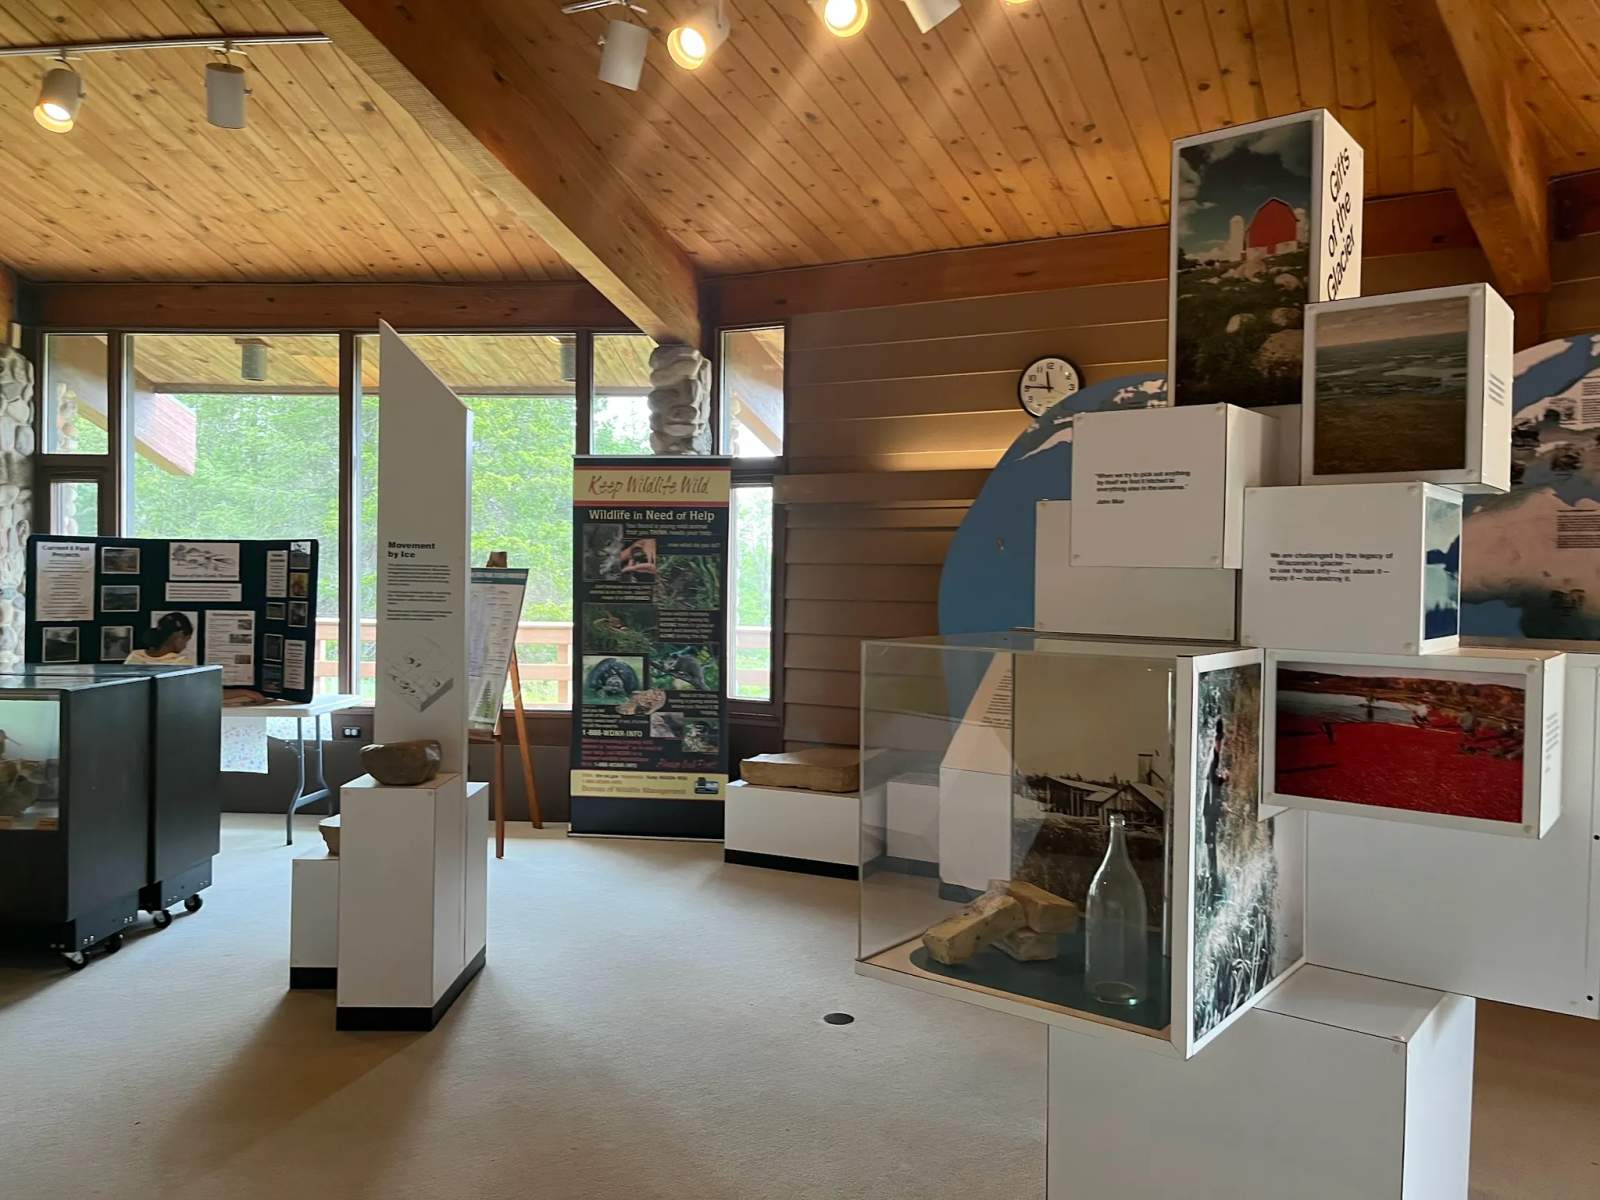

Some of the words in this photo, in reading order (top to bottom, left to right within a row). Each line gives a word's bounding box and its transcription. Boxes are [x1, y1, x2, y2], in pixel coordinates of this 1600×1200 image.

[1329, 147, 1351, 202] Gifts
[1328, 218, 1339, 258] of
[1335, 191, 1352, 234] the
[1326, 223, 1356, 301] Glacier
[1029, 374, 1037, 382] 10
[587, 475, 624, 499] Keep
[626, 475, 678, 496] Wildlife
[680, 475, 711, 495] Wild
[588, 509, 631, 521] Wildlife
[633, 510, 643, 520] in
[645, 510, 674, 521] Need
[676, 510, 687, 520] of
[689, 510, 716, 522] Help
[387, 541, 436, 550] Movement
[387, 550, 399, 559] by
